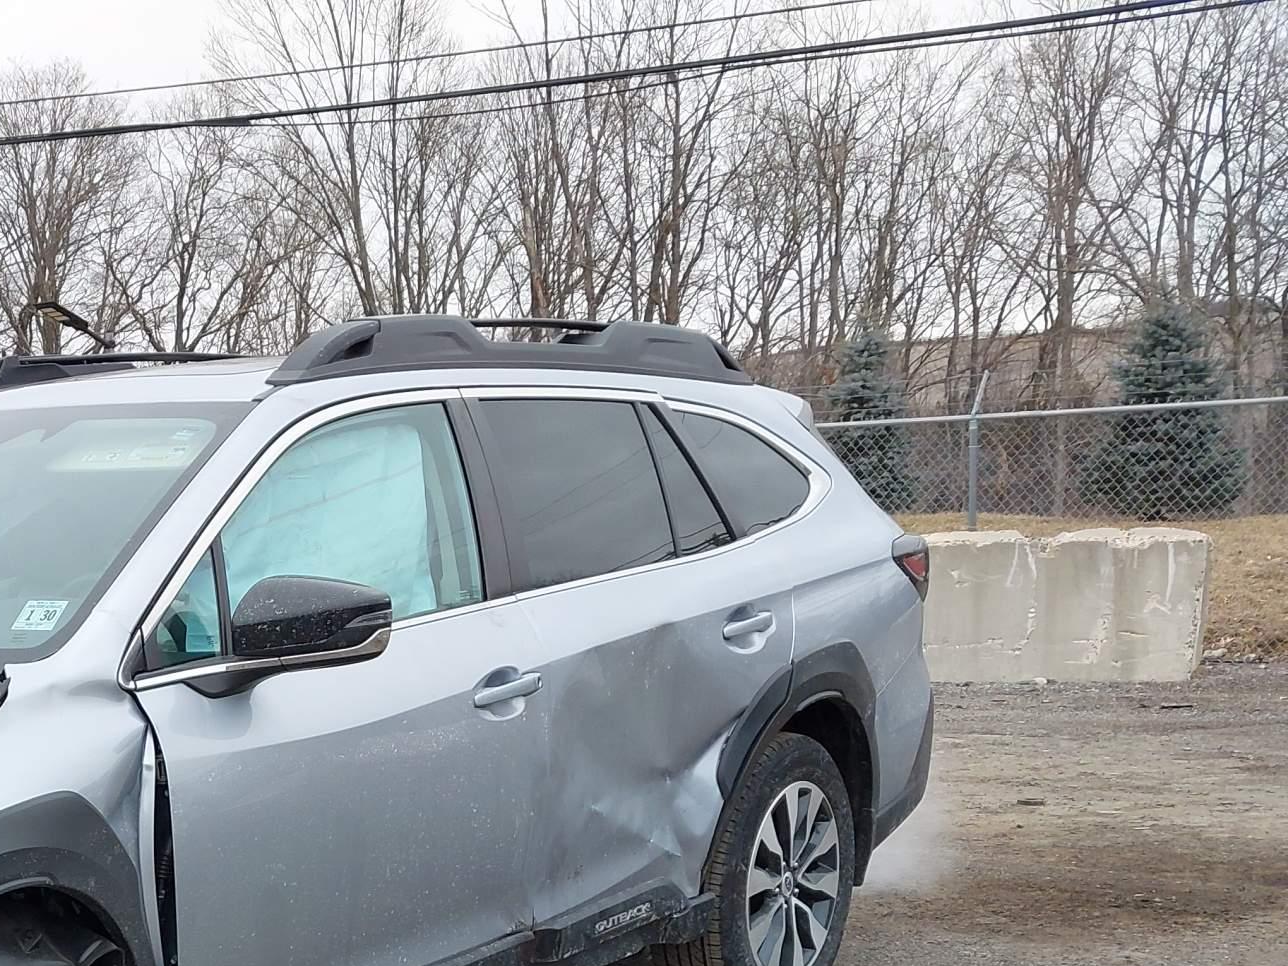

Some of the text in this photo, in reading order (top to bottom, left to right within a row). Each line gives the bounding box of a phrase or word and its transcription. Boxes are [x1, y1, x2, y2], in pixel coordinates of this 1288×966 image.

[24, 609, 58, 621] 1 30
[594, 902, 651, 932] OUTBACK
